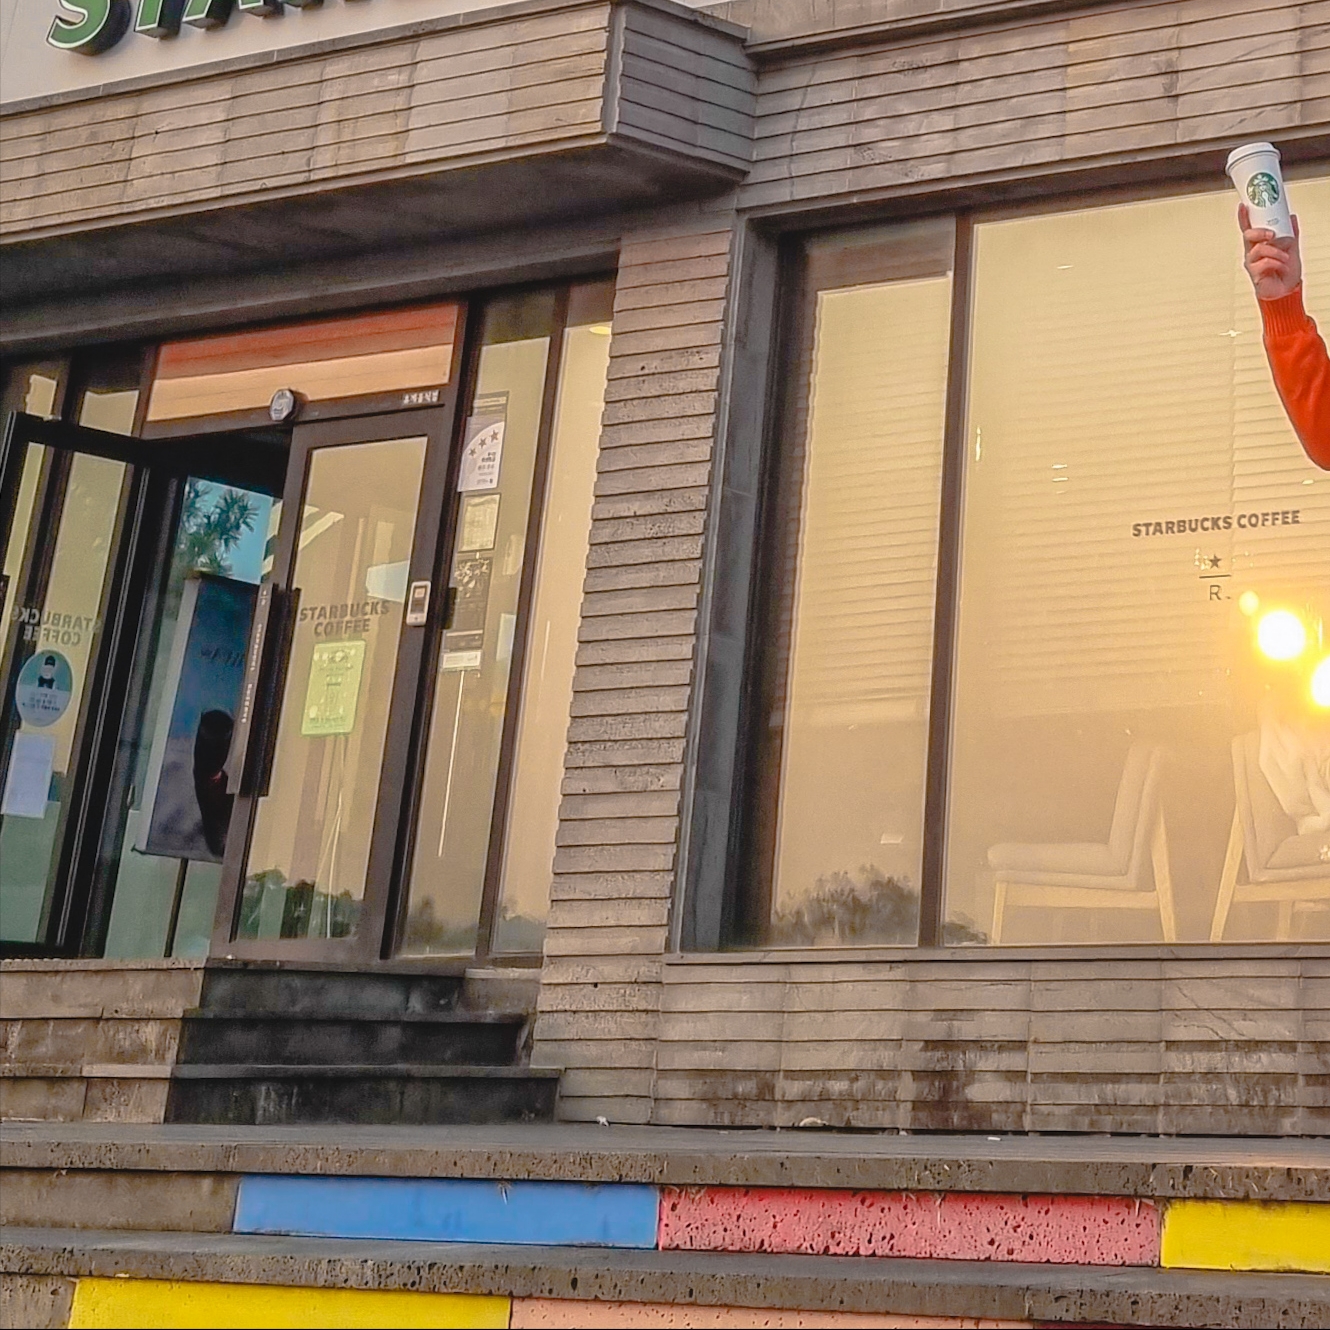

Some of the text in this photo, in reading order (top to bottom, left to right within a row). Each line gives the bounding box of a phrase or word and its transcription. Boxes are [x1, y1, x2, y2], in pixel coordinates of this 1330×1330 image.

[1132, 510, 1301, 537] STARBUCKS COFFEE
[1209, 584, 1222, 600] R
[299, 600, 391, 622] STARBUCKS
[314, 618, 371, 637] COFFEE
